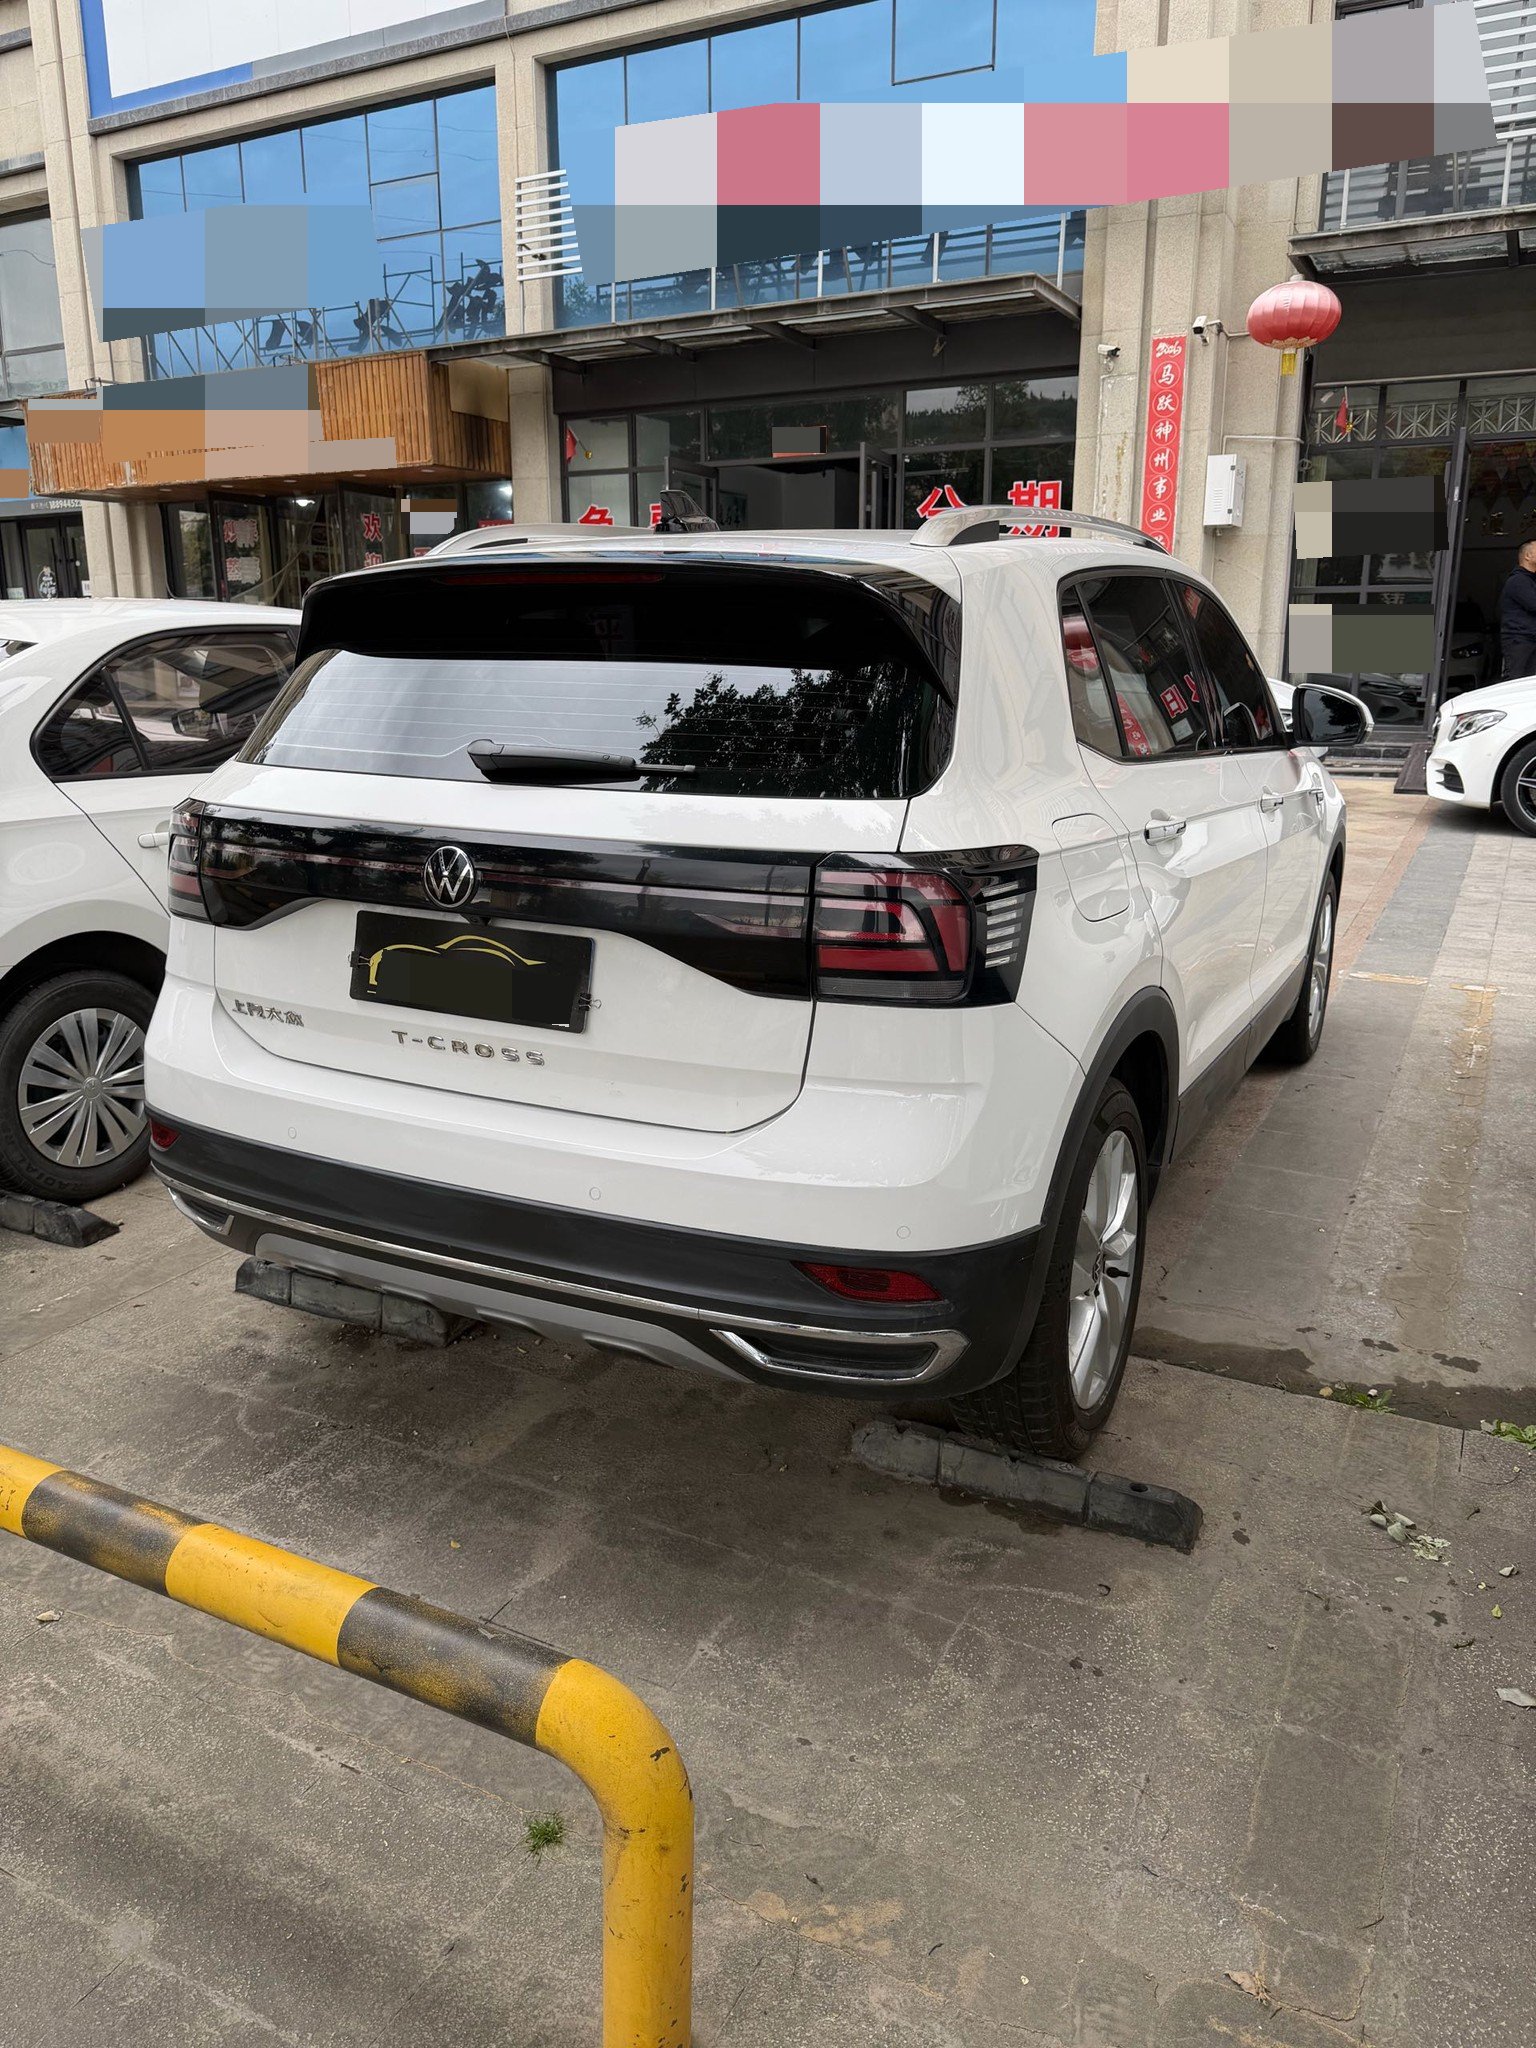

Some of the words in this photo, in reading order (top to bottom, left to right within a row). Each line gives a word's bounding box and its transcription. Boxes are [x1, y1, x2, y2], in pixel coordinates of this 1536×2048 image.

[232, 998, 305, 1028] 上汽大众
[391, 1029, 546, 1067] T-CROSS
